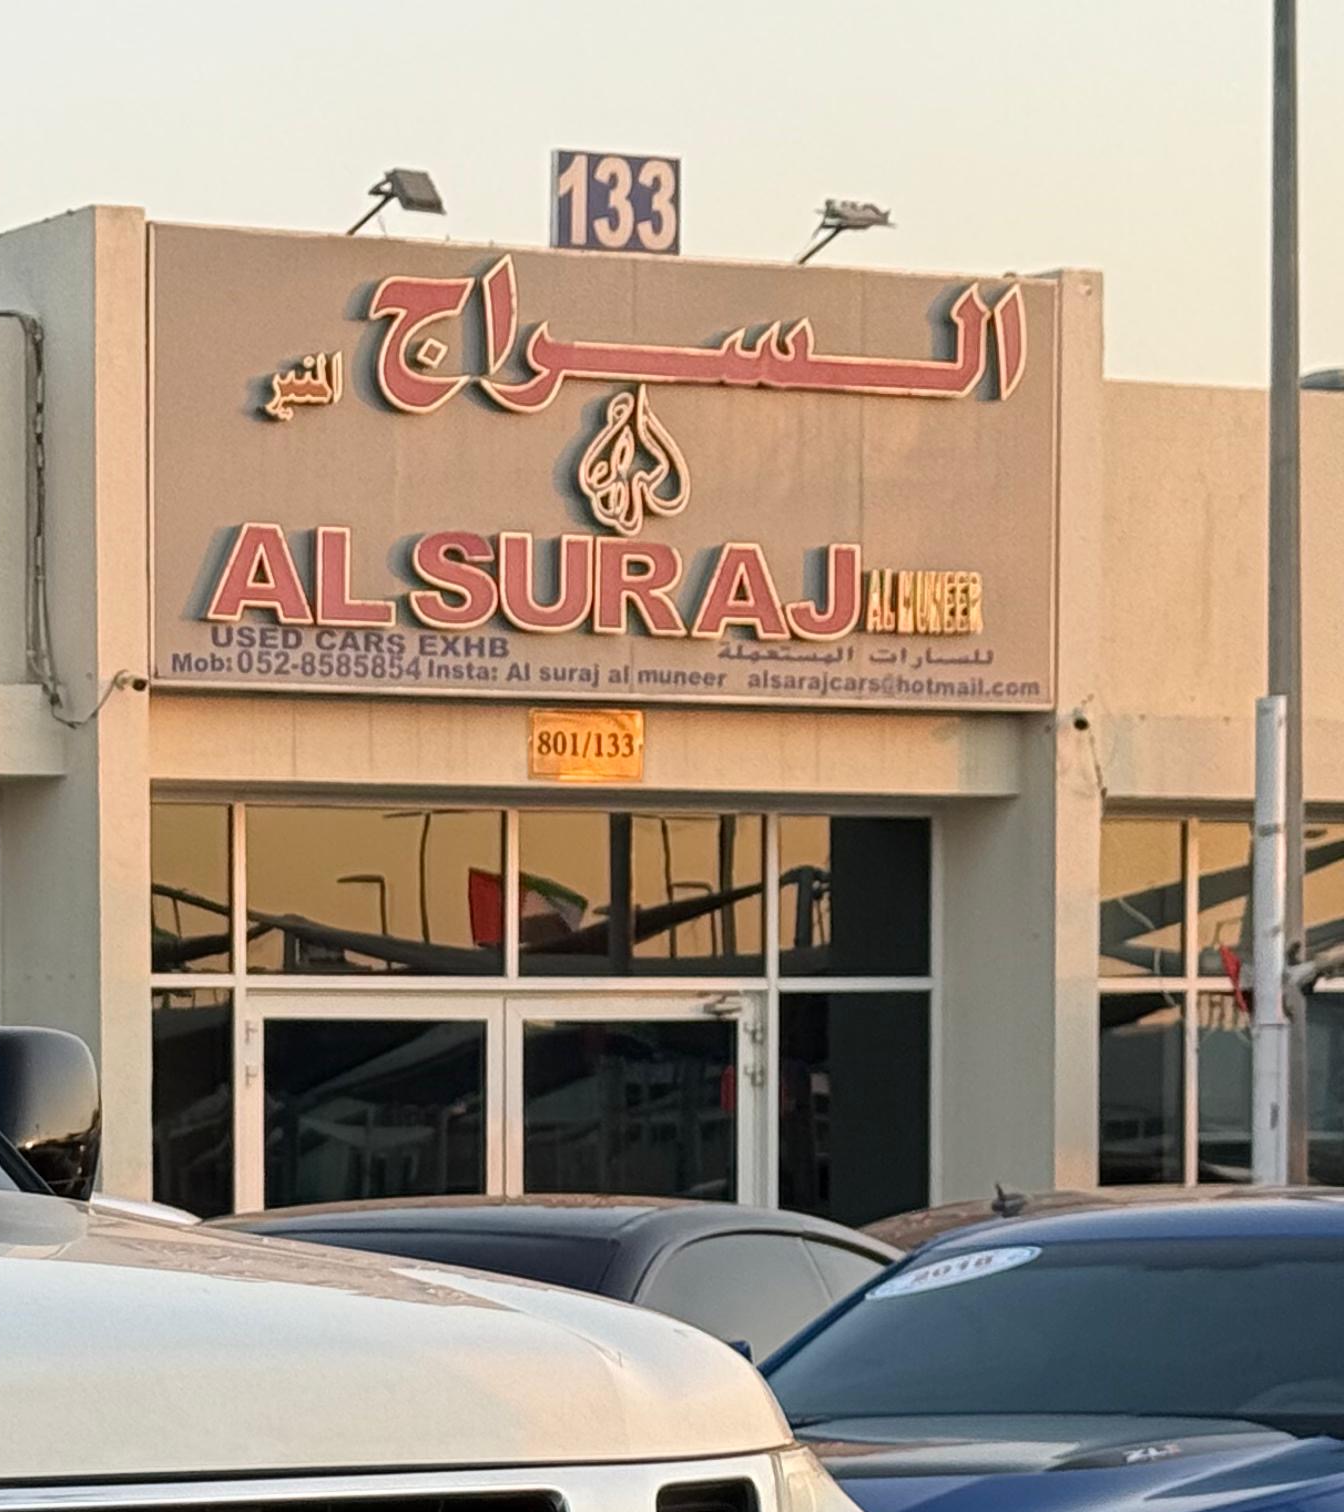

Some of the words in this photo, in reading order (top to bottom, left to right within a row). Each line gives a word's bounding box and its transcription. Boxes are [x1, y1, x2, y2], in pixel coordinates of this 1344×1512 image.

[558, 154, 677, 251] 133
[368, 253, 1029, 414] السراج
[265, 351, 343, 421] المنير
[208, 522, 396, 628] AL
[408, 530, 862, 640] SURAJ
[171, 652, 233, 674] Mob:
[237, 649, 421, 681] 052-8585854
[427, 658, 499, 682] Insta:
[506, 662, 531, 682] Al
[539, 664, 600, 688] suraj
[608, 665, 630, 684] al
[637, 668, 727, 687] muneer
[211, 625, 303, 649] USED
[315, 629, 406, 655] CARS
[418, 634, 509, 659] EXHB
[537, 731, 634, 758] 801/133
